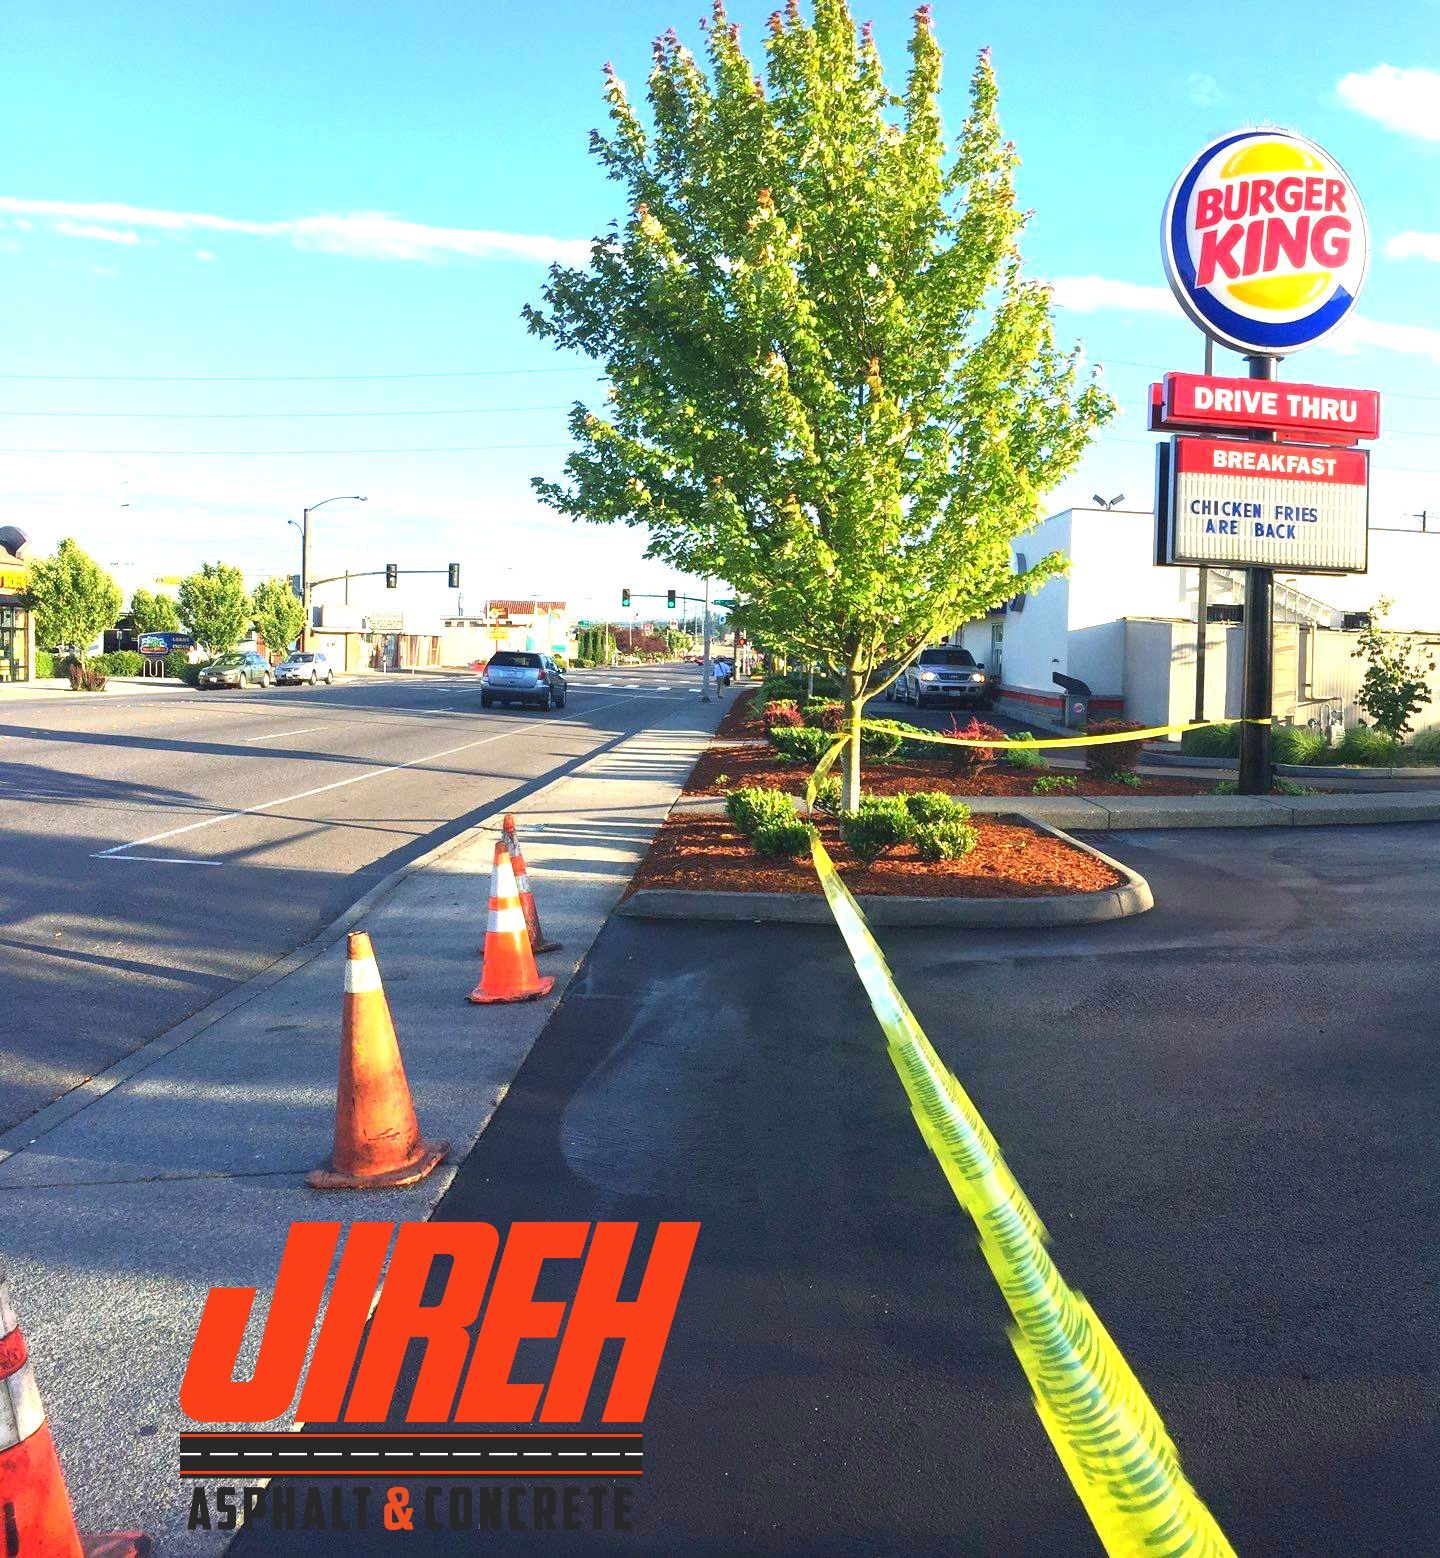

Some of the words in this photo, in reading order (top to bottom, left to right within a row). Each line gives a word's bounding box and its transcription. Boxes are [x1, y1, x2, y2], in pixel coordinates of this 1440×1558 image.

[1195, 176, 1346, 229] BURGER
[1196, 215, 1351, 287] KING
[1194, 386, 1278, 415] DRIVE
[1287, 394, 1358, 422] THRU
[1213, 449, 1337, 476] BREAKFAST
[1190, 499, 1262, 519] CHICKEN
[1275, 505, 1318, 523] FRIES
[1205, 518, 1239, 535] ARE
[1254, 522, 1296, 539] BACK
